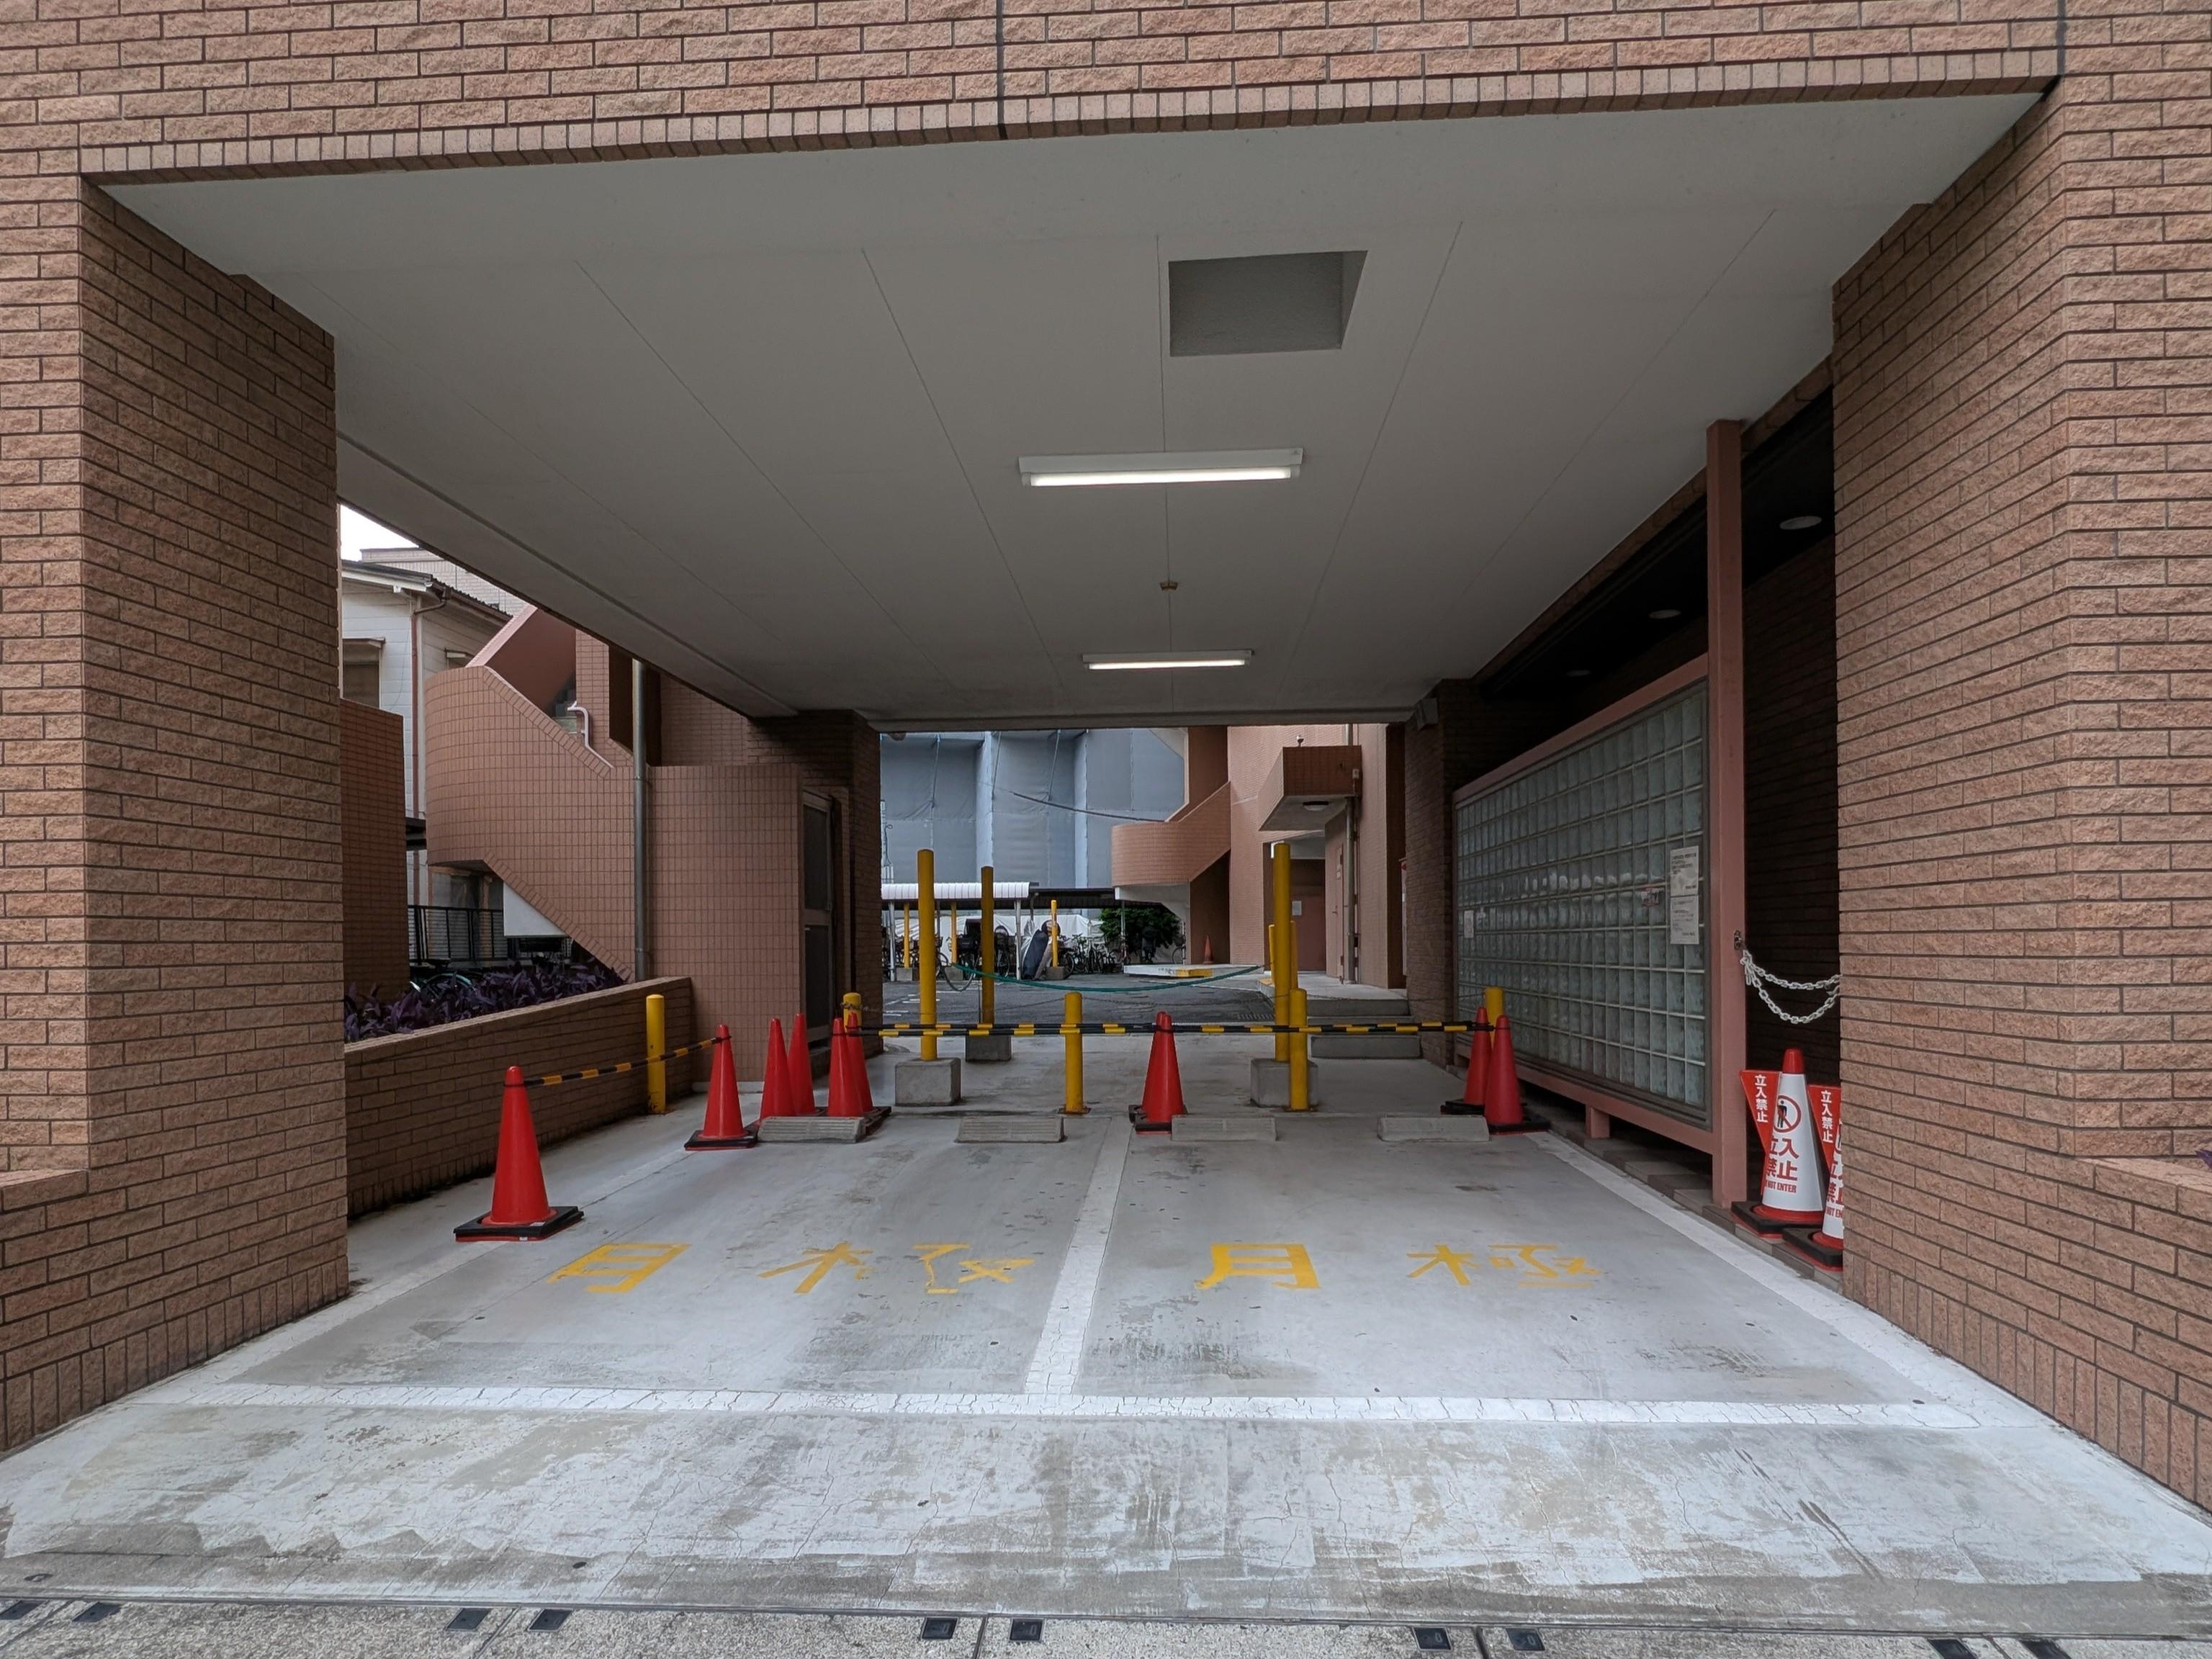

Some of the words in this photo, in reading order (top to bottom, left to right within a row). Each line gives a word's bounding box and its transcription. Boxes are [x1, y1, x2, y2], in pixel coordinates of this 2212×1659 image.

[1755, 1074, 1768, 1123] 立入禁止
[1821, 1090, 1833, 1143] 立入禁止
[1776, 1182, 1797, 1193] ENTER
